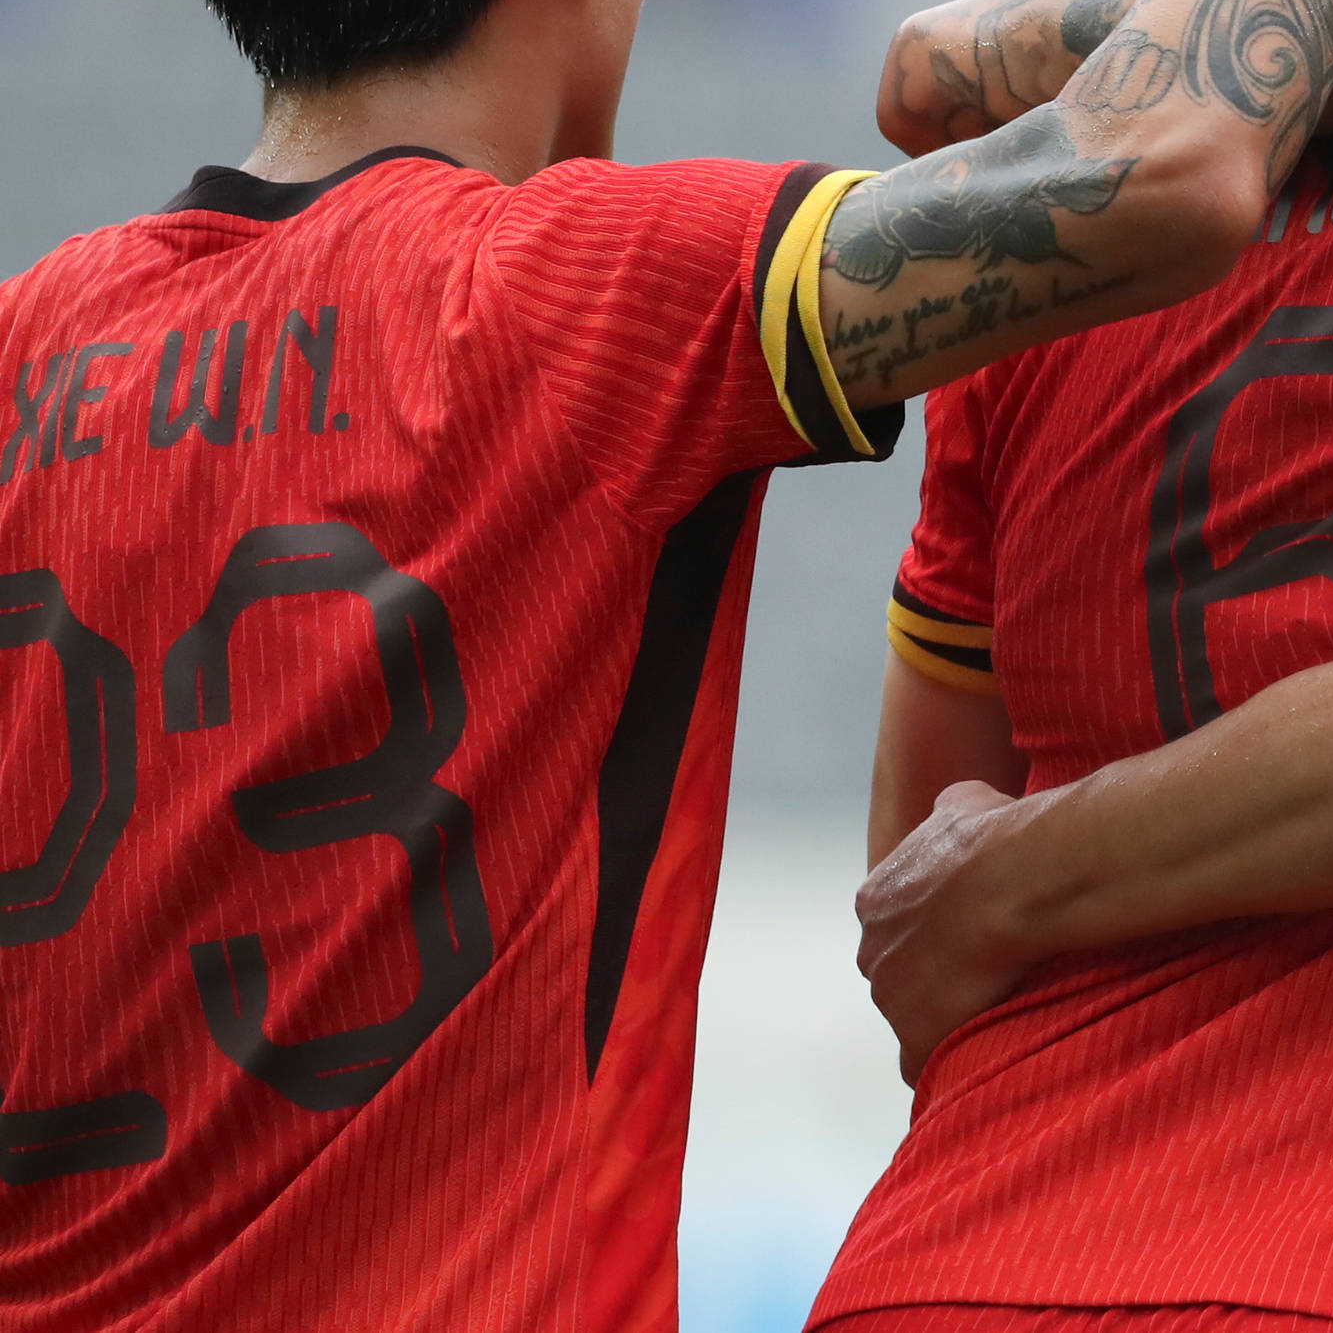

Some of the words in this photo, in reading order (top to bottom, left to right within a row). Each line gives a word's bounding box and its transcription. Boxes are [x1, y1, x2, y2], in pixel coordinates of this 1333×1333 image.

[823, 308, 894, 351] here
[0, 341, 135, 486] XIE
[148, 305, 350, 450] W.N.
